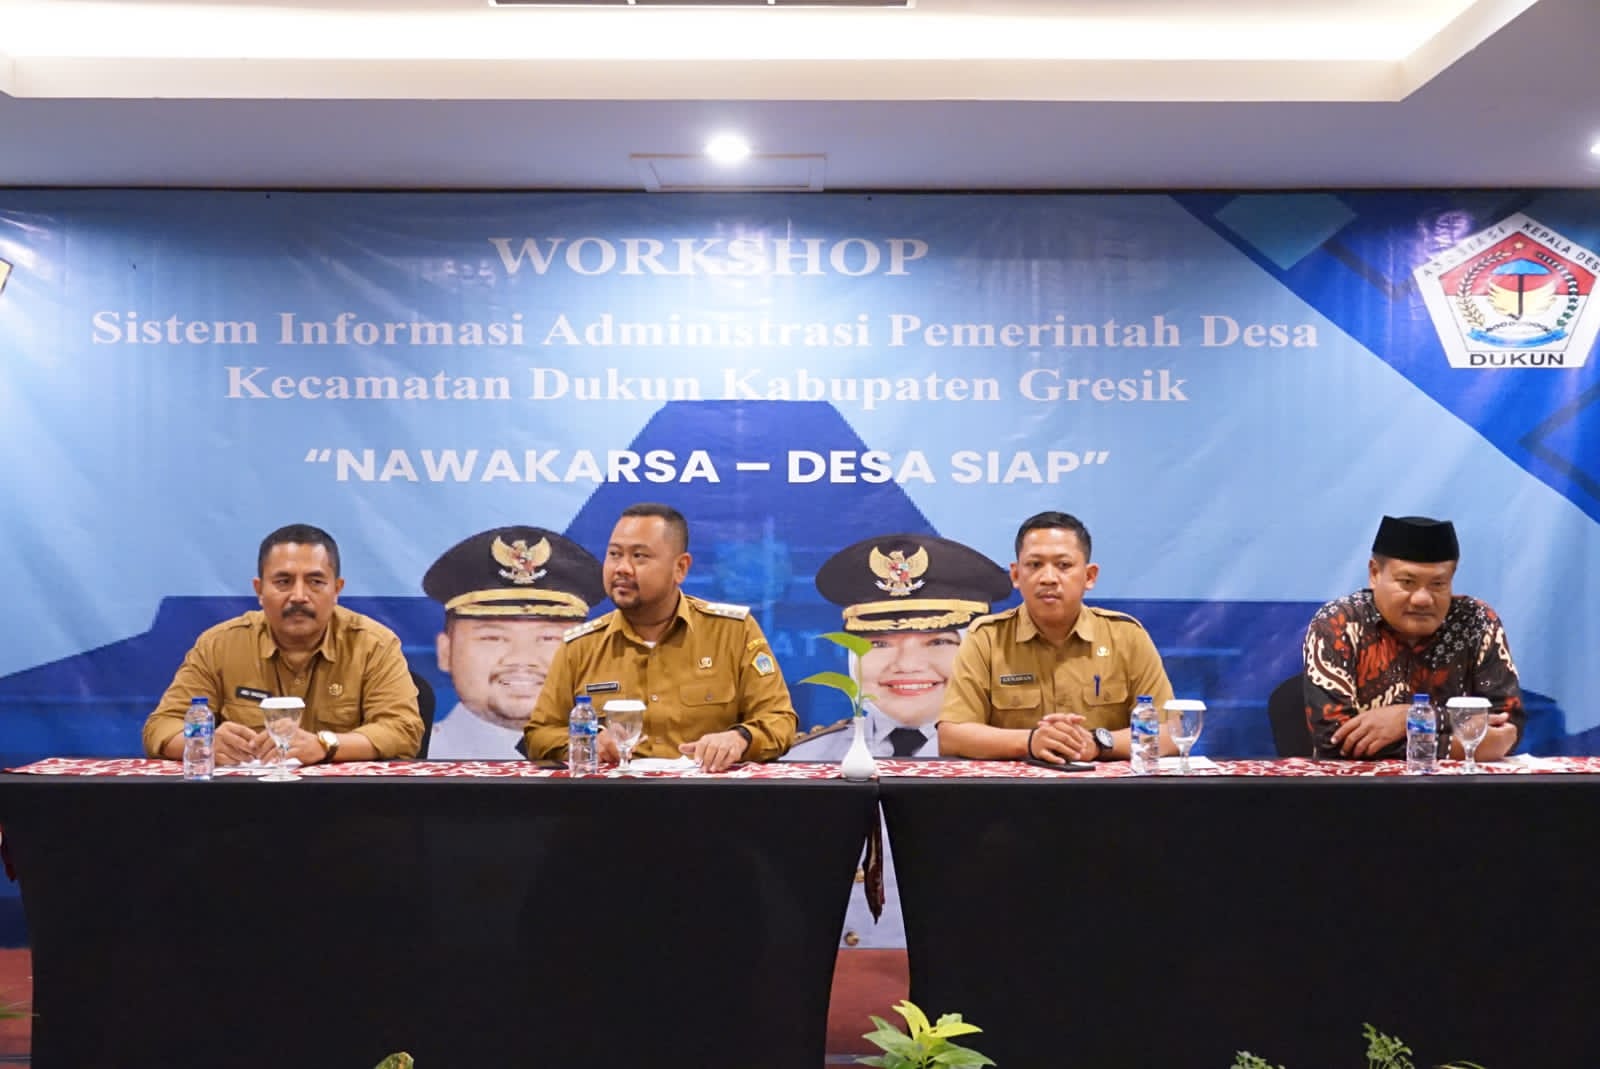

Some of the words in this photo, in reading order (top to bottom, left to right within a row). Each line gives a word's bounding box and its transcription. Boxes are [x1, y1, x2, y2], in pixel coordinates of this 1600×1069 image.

[1522, 222, 1571, 253] KEPALA
[491, 237, 930, 277] WORKSHOP
[92, 312, 258, 347] Sistem
[279, 312, 525, 347] Informasi
[546, 313, 869, 348] Administrasi
[889, 314, 1181, 349] Pemerintah
[1201, 315, 1319, 349] Desa
[1470, 353, 1564, 366] DUKUN
[226, 367, 511, 401] Kecamatan
[531, 368, 703, 401] Dukun
[723, 369, 1000, 411] Kabupaten
[1020, 369, 1189, 403] Gresik
[304, 448, 720, 484] “NAWAKARSA
[788, 450, 936, 484] DESA
[951, 450, 1110, 485] SIAP”
